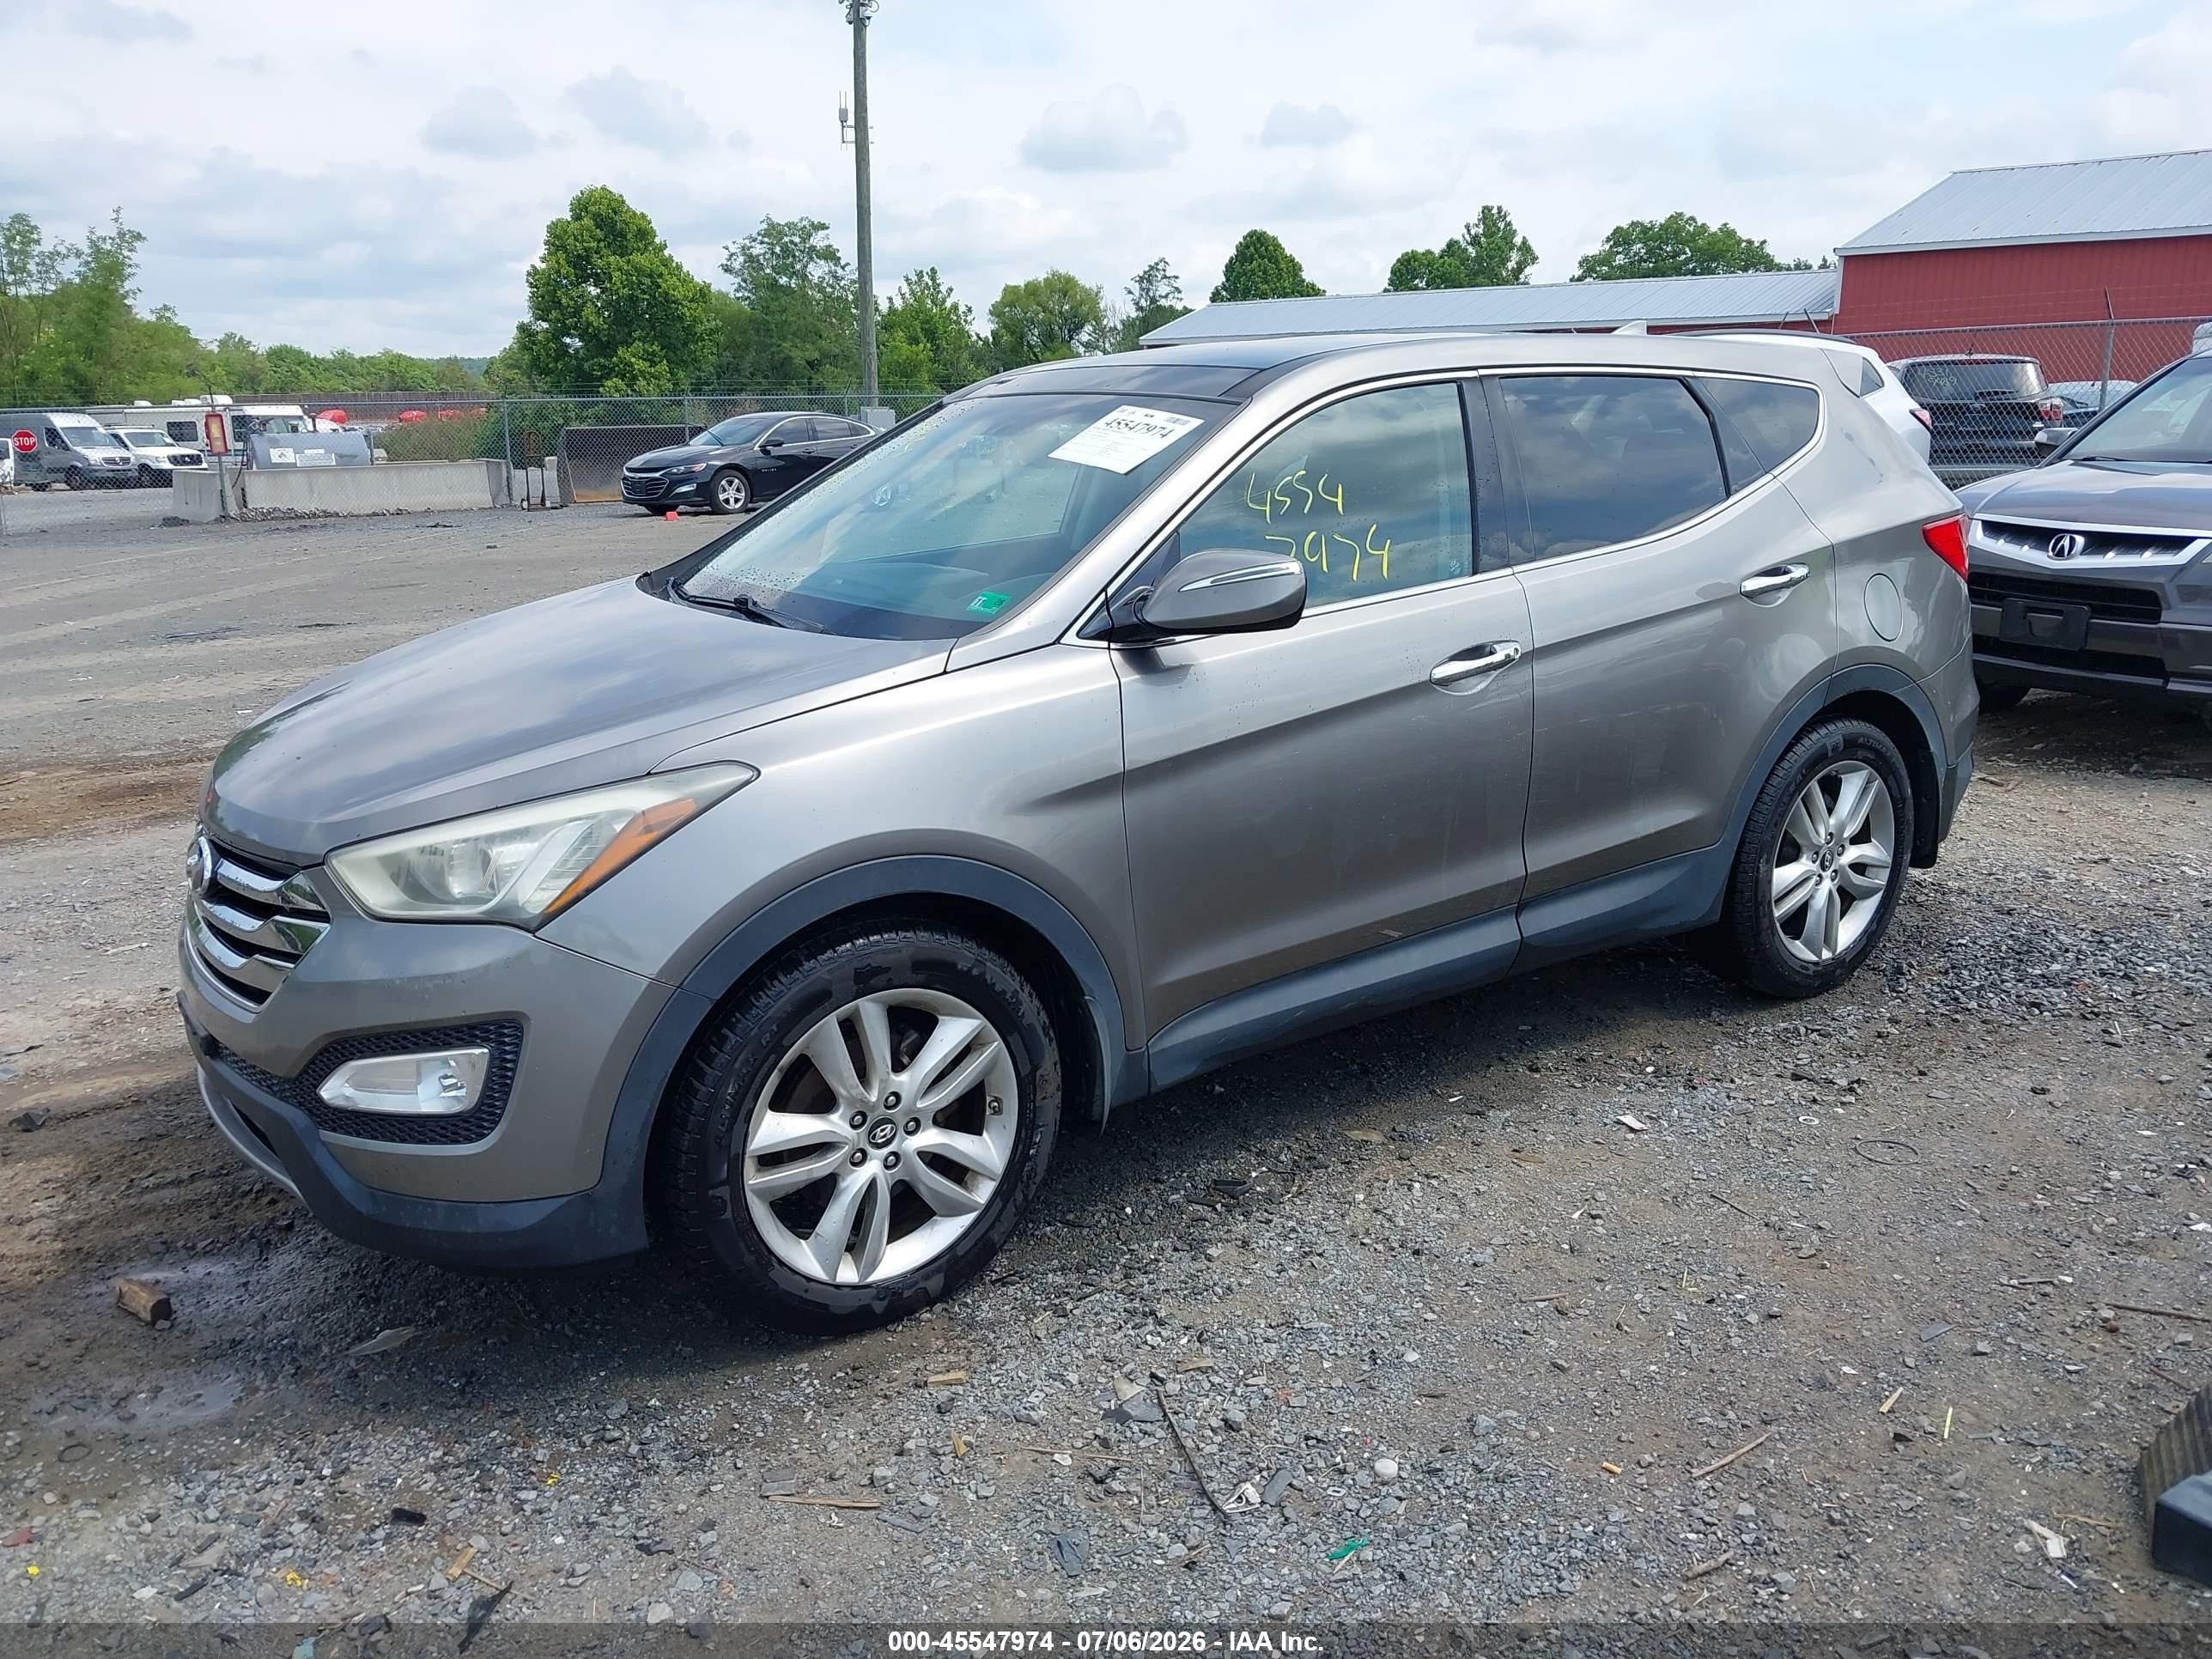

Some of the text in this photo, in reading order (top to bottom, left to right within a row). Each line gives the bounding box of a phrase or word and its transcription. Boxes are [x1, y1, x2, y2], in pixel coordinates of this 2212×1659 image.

[14, 436, 35, 446] STOP
[1104, 417, 1175, 439] 45547974
[1246, 470, 1345, 525] 4554
[1265, 522, 1392, 581] 7974
